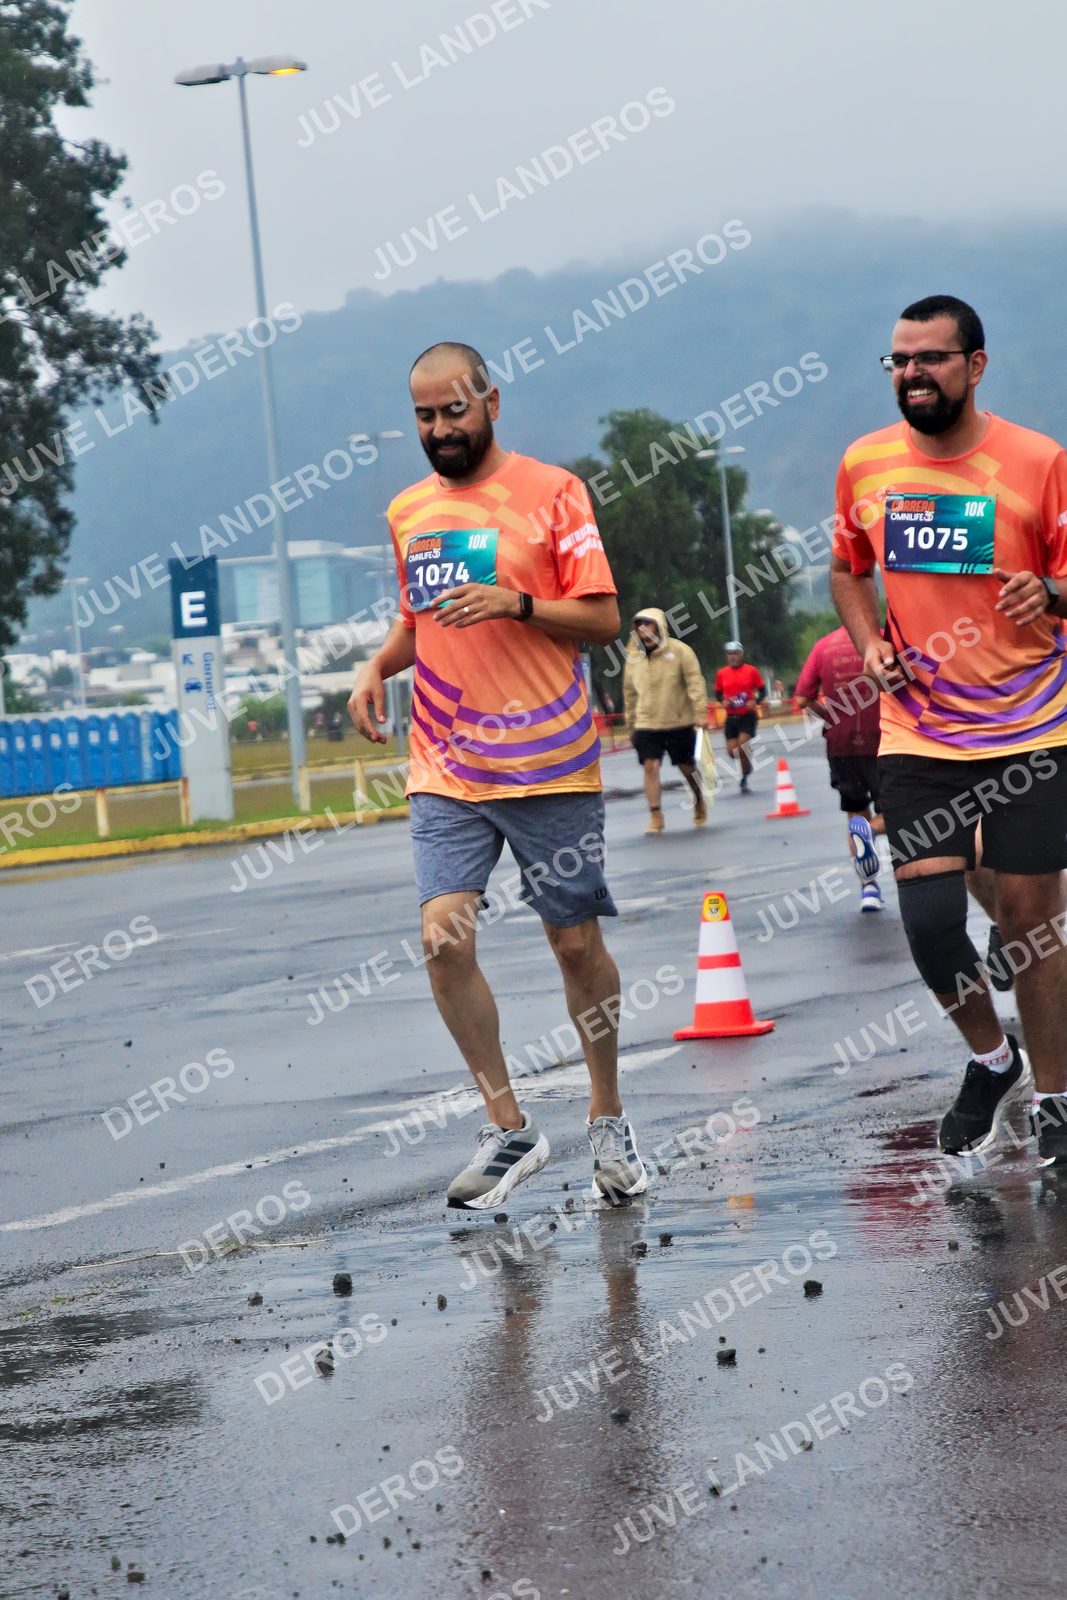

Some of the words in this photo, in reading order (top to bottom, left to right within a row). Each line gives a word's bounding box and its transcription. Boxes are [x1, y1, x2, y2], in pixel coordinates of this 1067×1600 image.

[891, 500, 936, 512] CARRERA
[964, 501, 987, 517] 10K
[468, 534, 489, 550] 10K
[903, 526, 968, 551] 1075
[415, 561, 470, 587] 1074
[180, 590, 208, 627] E
